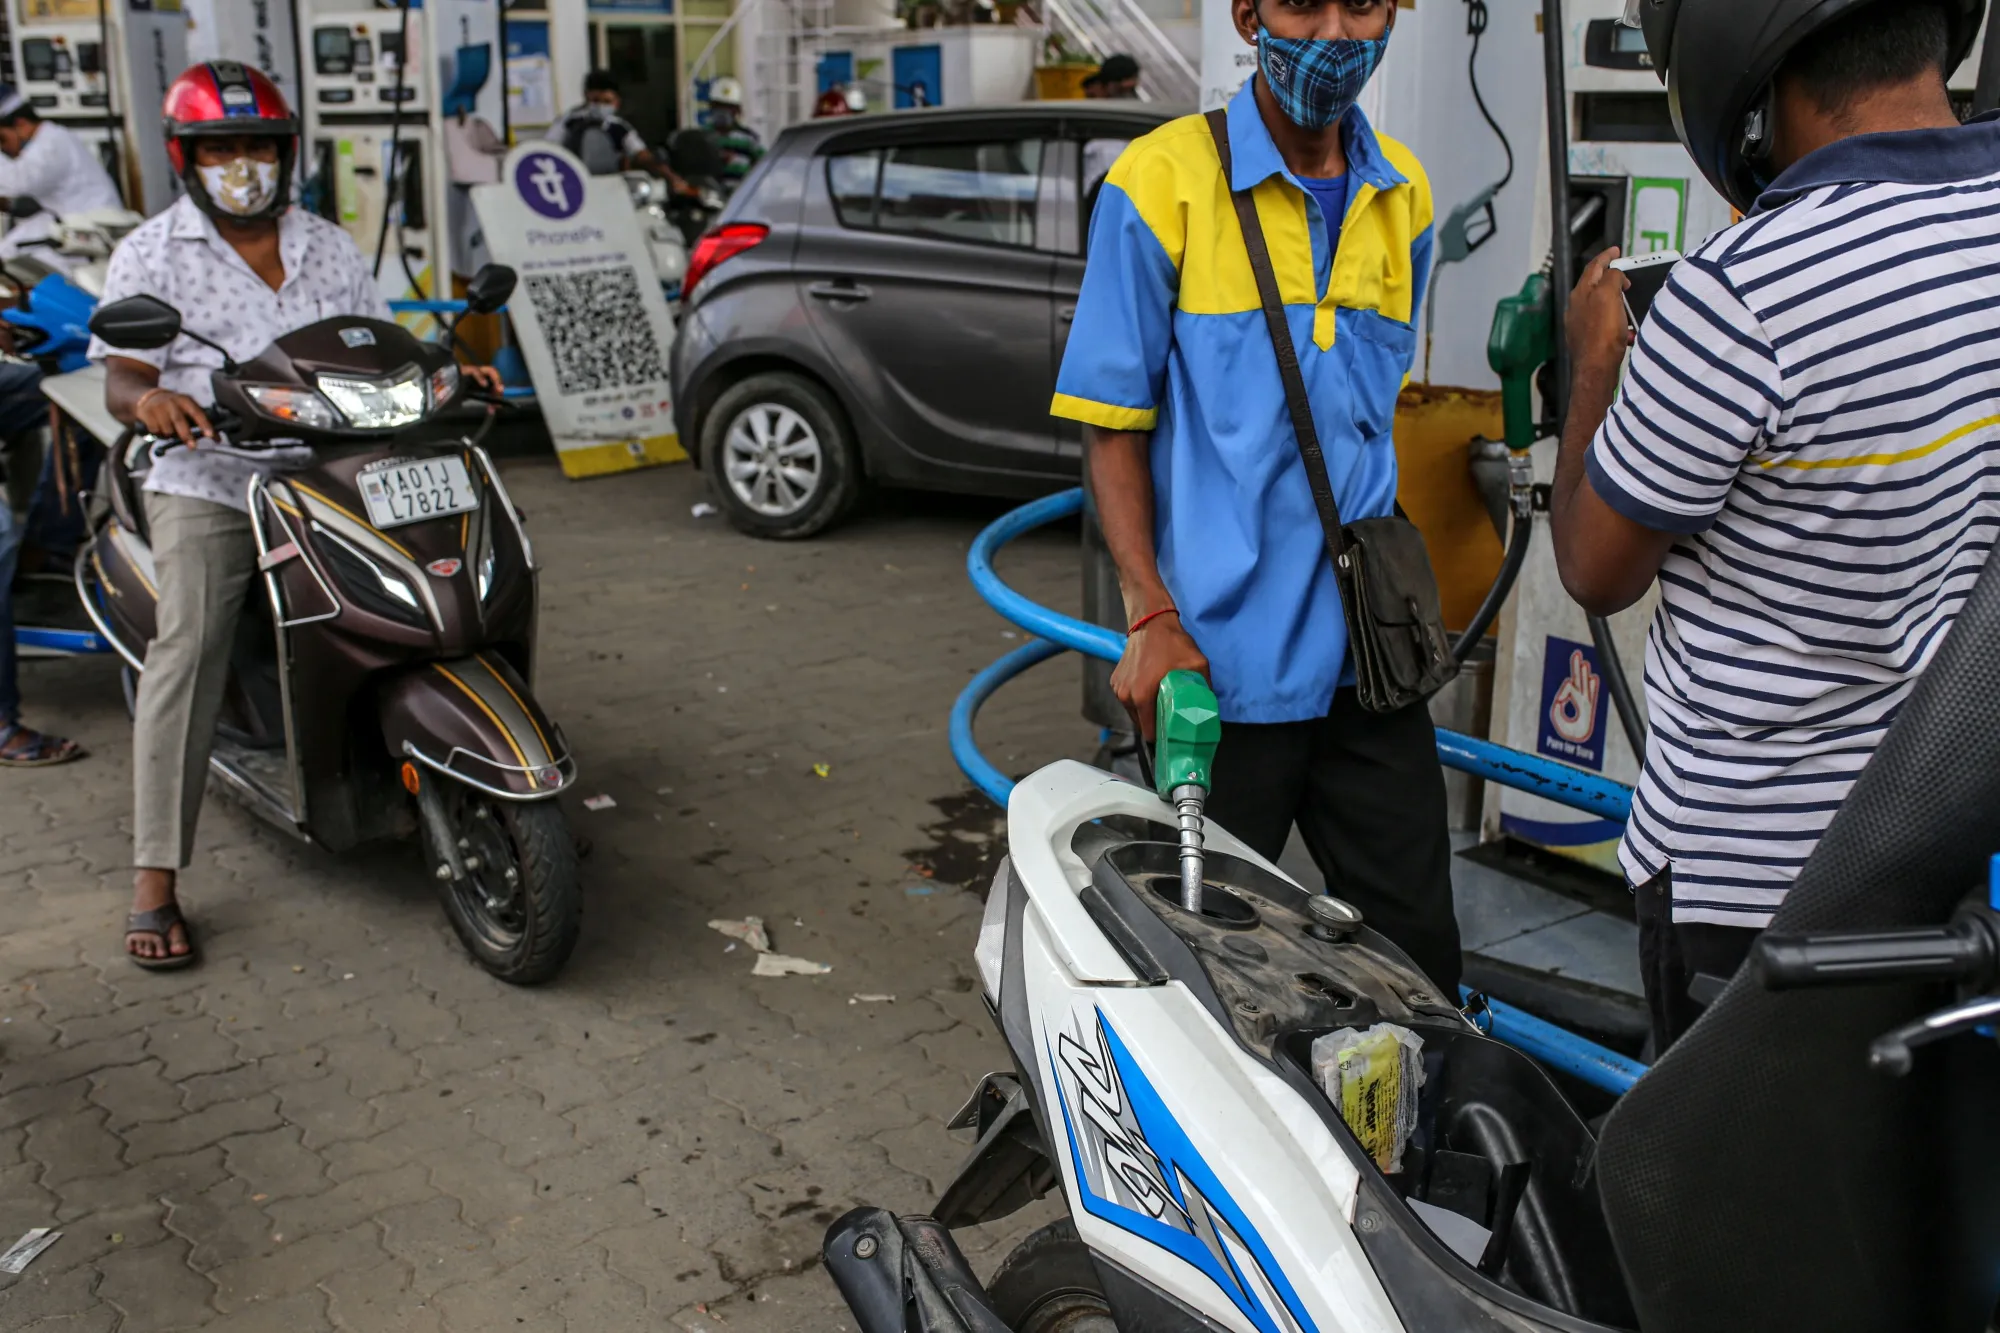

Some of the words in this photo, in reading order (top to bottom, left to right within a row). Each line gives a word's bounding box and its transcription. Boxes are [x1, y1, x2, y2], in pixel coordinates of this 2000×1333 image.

[380, 462, 450, 499] KA01J
[388, 486, 459, 520] L7822
[1546, 735, 1564, 752] Pure
